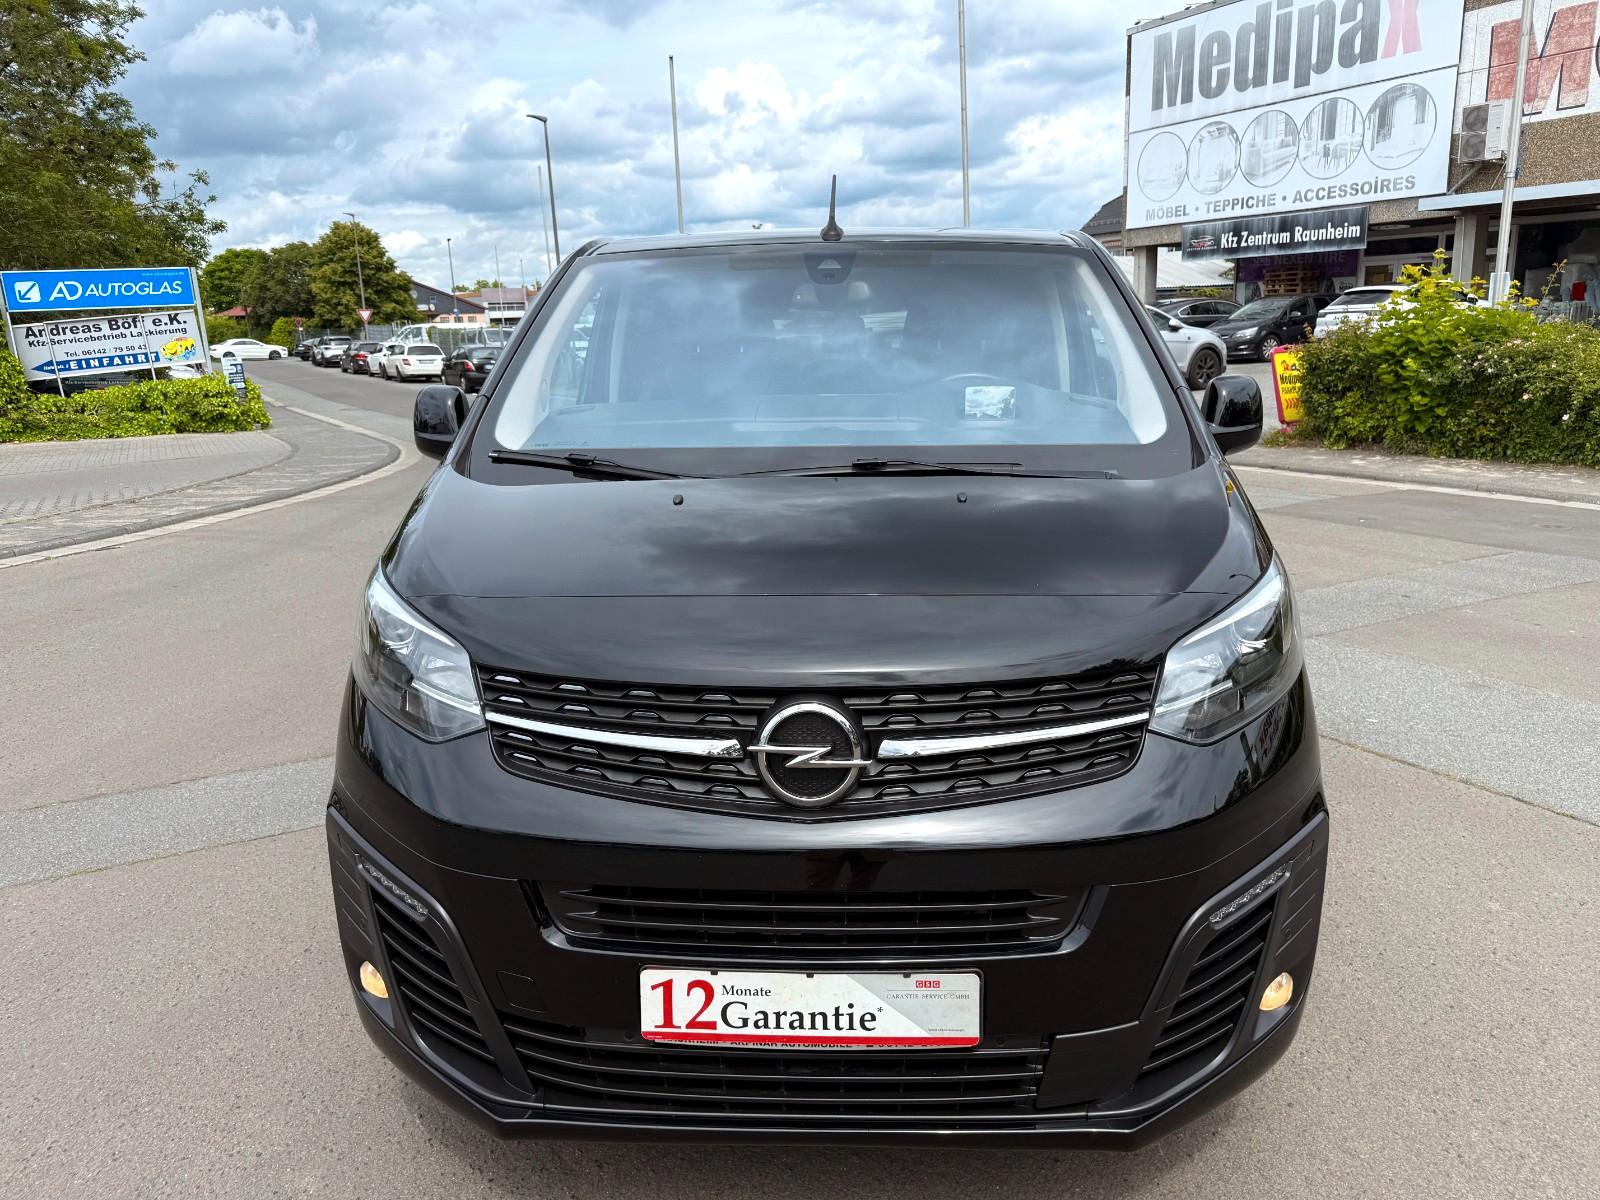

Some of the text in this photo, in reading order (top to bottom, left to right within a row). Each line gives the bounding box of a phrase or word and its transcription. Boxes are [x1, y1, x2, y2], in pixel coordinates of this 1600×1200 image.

[1151, 0, 1422, 112] Medipax
[1486, 0, 1600, 117] M
[1145, 204, 1190, 222] MÖBEL
[1204, 192, 1277, 214] TEPPICHE
[1221, 222, 1361, 249] Kfz Zentrum Raunheim
[49, 281, 182, 301] AD AUTOGLAS
[152, 313, 187, 327] e.K.
[28, 327, 187, 348] Kfz-Servicebetrieb Lackierung
[69, 353, 157, 370] EINFAHRT
[651, 978, 772, 1030] 12 Monate
